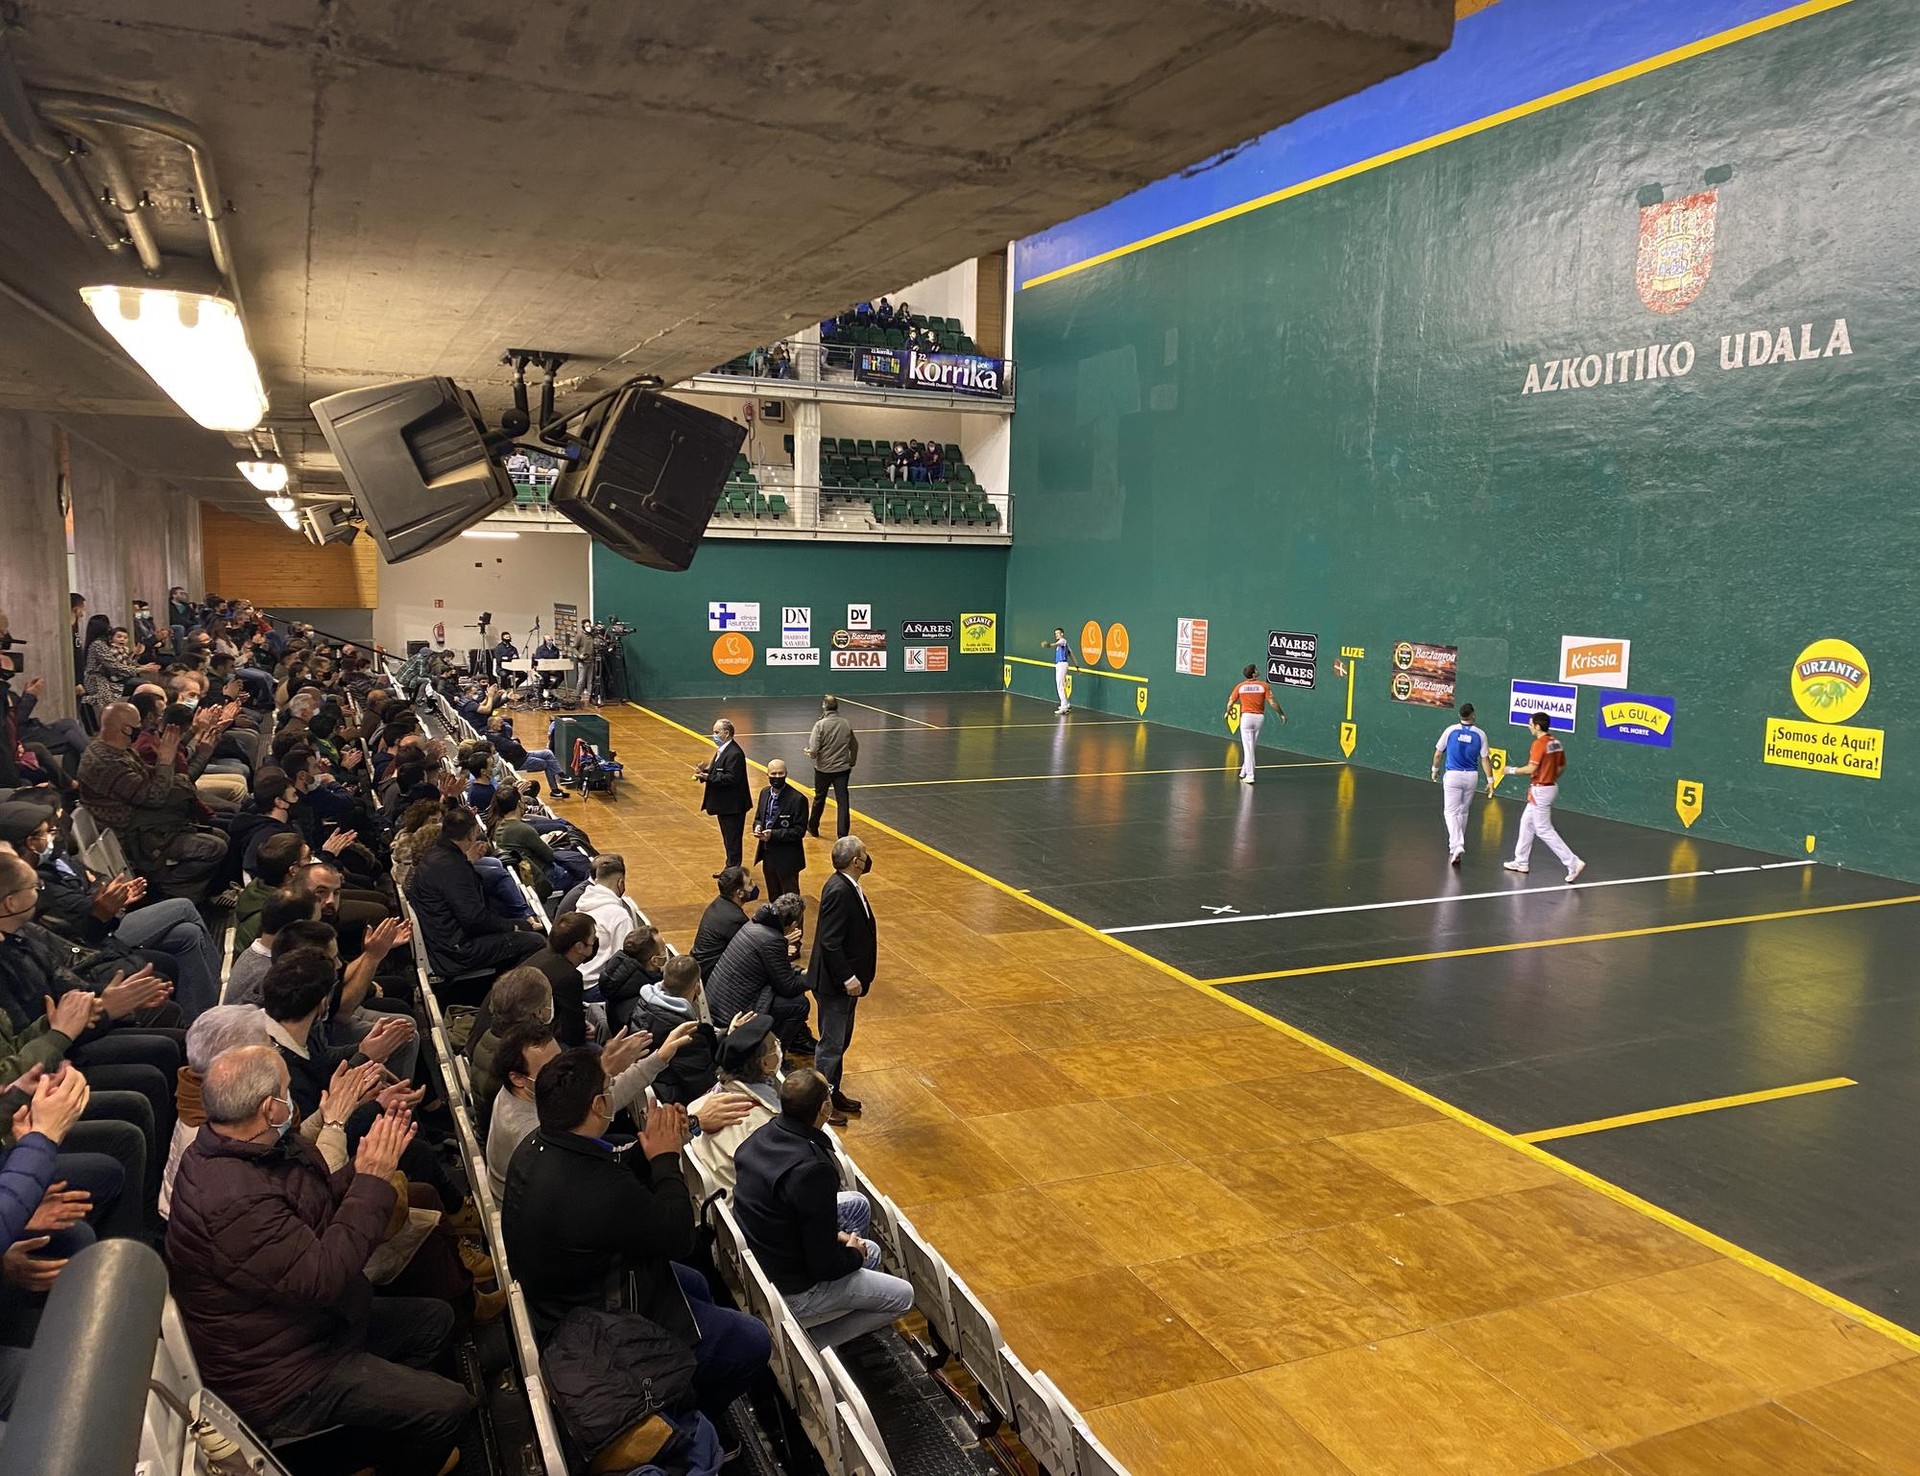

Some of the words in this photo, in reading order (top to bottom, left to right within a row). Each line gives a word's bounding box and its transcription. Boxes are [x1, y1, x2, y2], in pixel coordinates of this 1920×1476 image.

[1521, 340, 1695, 395] AZKOITIKO
[1720, 318, 1854, 370] UDALA
[909, 351, 997, 391] korrika
[785, 608, 808, 624] DN
[851, 609, 867, 620] DV
[964, 616, 992, 627] URZANTE
[904, 623, 952, 633] AÑARES
[1269, 636, 1315, 651] AÑARES
[836, 652, 880, 666] GARA
[1341, 646, 1364, 658] LUZE
[1415, 648, 1456, 664] Baztangoa
[1571, 650, 1617, 670] Krissia
[1268, 663, 1313, 679] AÑARES
[1801, 660, 1861, 682] URZANTE
[1413, 679, 1454, 695] Baztangoa
[1139, 691, 1145, 702] 9
[1230, 707, 1237, 720] 8
[1514, 697, 1572, 714] AGUINAMAR
[1610, 709, 1625, 721] LA
[1344, 727, 1353, 742] 7
[1619, 726, 1629, 734] DEL
[1630, 727, 1649, 736] NORTE
[1772, 727, 1817, 744] ¡Somos
[1822, 732, 1837, 746] de
[1840, 734, 1876, 752] Aquí!
[1491, 753, 1502, 770] 6
[1767, 743, 1838, 765] Hemengoak
[1843, 753, 1879, 770] Gara!
[1682, 787, 1696, 806] 5
